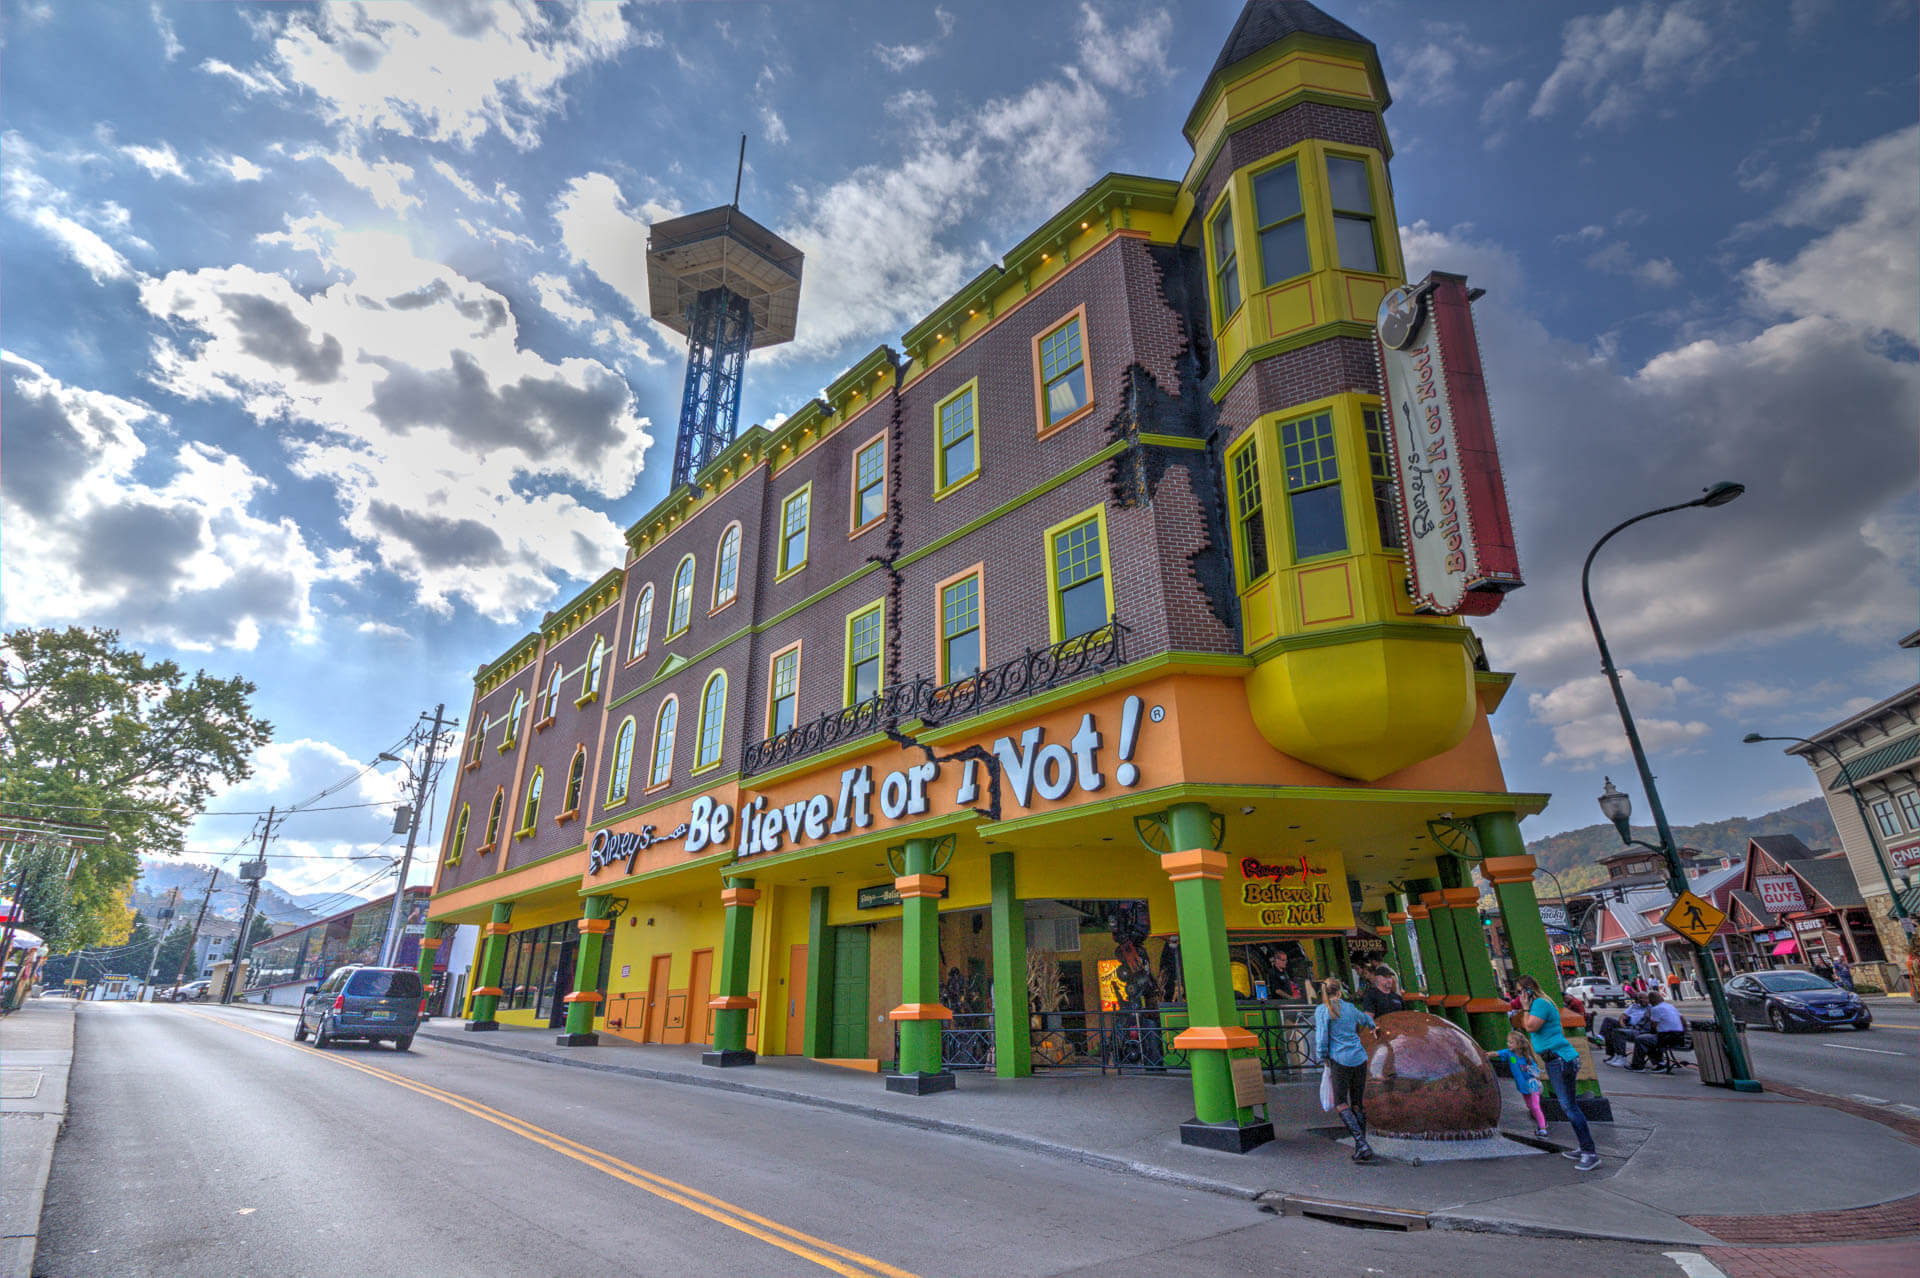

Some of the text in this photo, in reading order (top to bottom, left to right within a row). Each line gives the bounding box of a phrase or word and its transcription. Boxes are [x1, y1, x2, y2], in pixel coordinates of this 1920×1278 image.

[1409, 345, 1467, 575] Believe It or Not!
[830, 765, 875, 835] It
[880, 761, 941, 820] or
[1243, 882, 1332, 905] Believe It
[1763, 882, 1796, 893] FIVE
[1764, 892, 1802, 904] GUYS
[1261, 902, 1326, 926] or Not!
